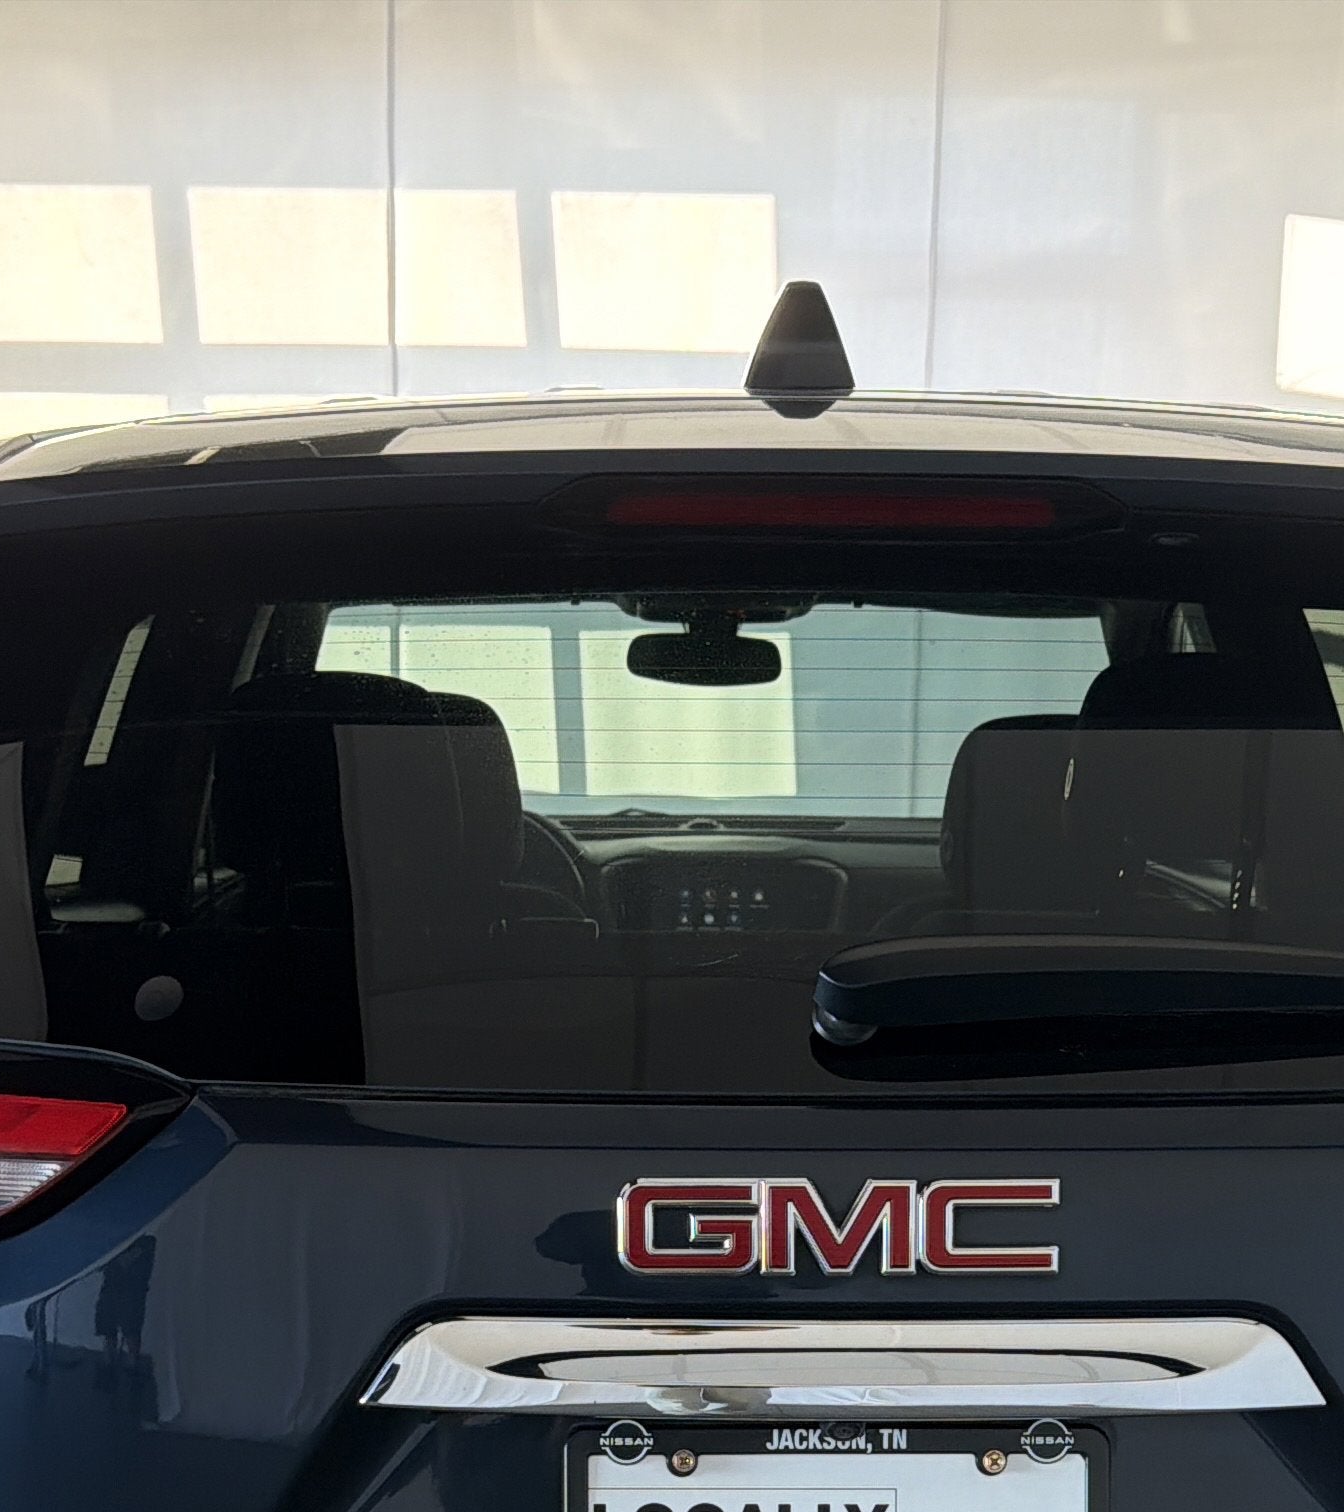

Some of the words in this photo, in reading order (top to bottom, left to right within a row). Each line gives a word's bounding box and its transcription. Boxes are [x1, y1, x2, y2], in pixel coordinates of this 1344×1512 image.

[616, 1177, 1061, 1276] GMC
[599, 1437, 654, 1446] NISSAN
[879, 1429, 907, 1450] TN
[1020, 1436, 1075, 1445] NISSAN
